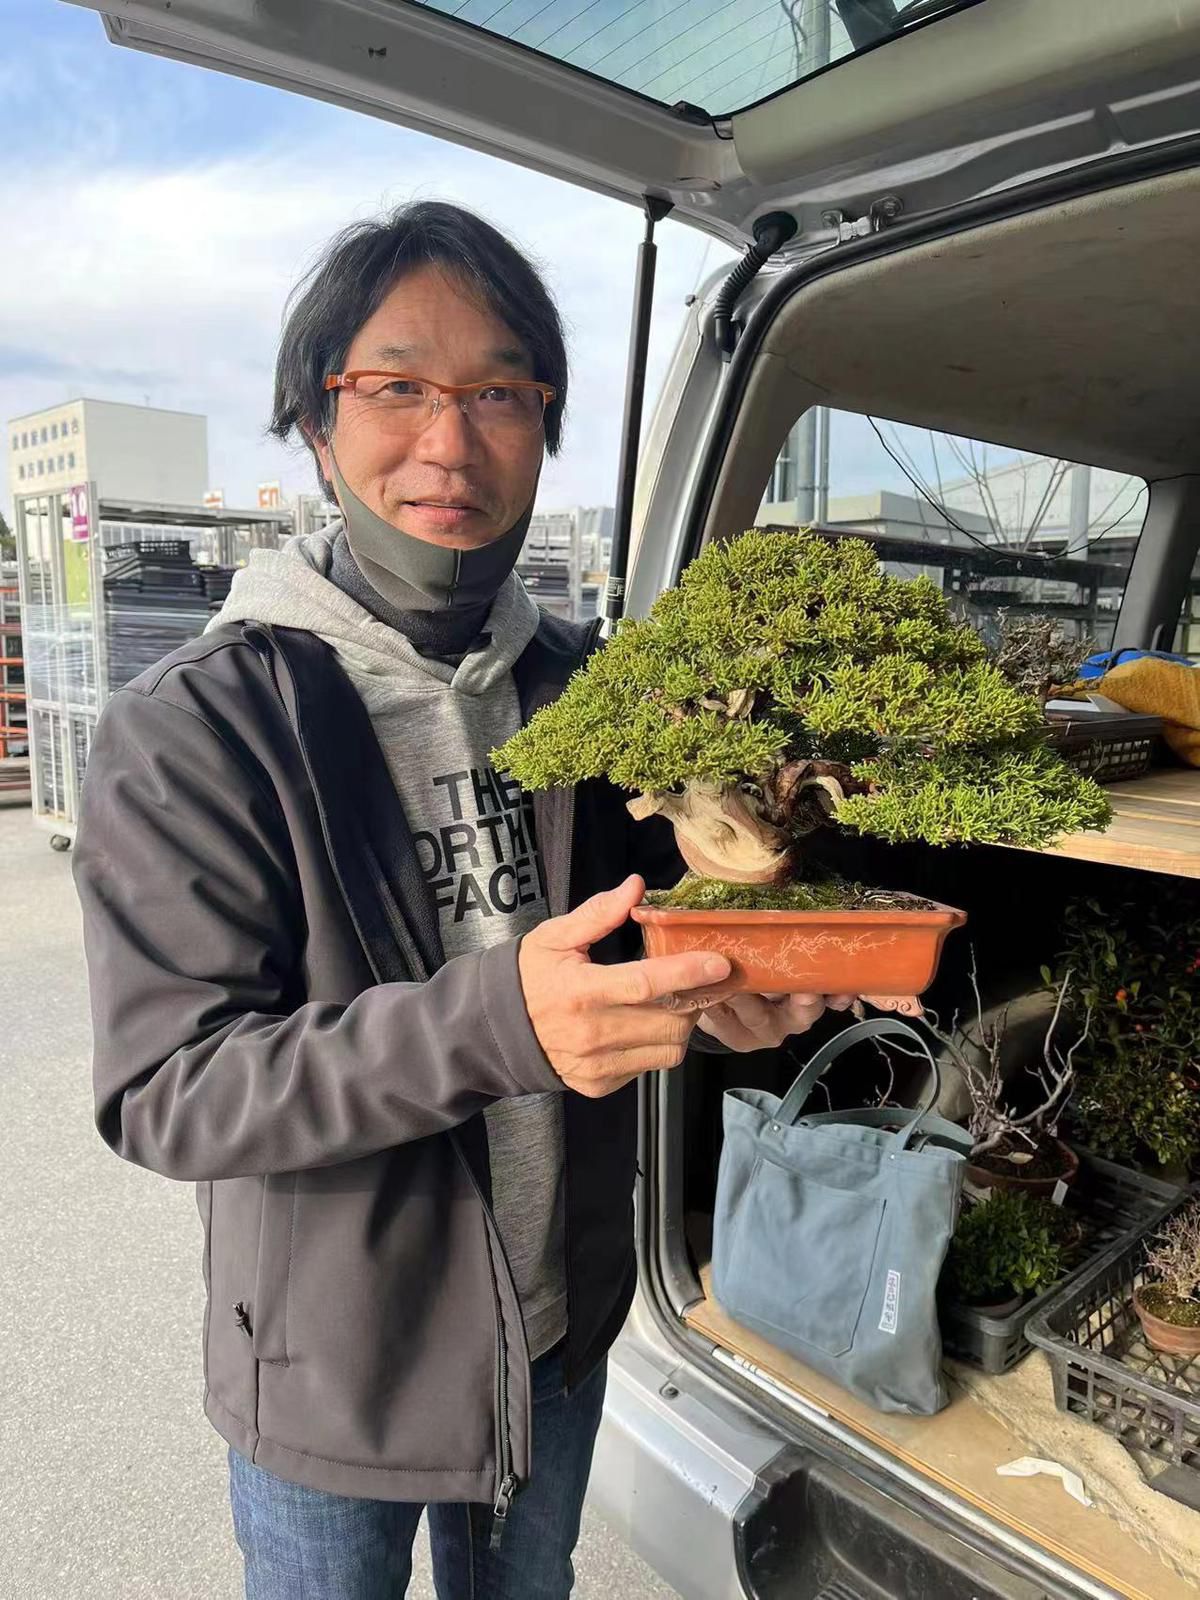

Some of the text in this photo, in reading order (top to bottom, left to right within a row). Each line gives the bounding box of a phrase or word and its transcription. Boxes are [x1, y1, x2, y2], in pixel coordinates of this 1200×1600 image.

[433, 768, 521, 820] THE
[413, 810, 528, 878] ORTH
[429, 857, 536, 923] FACE
